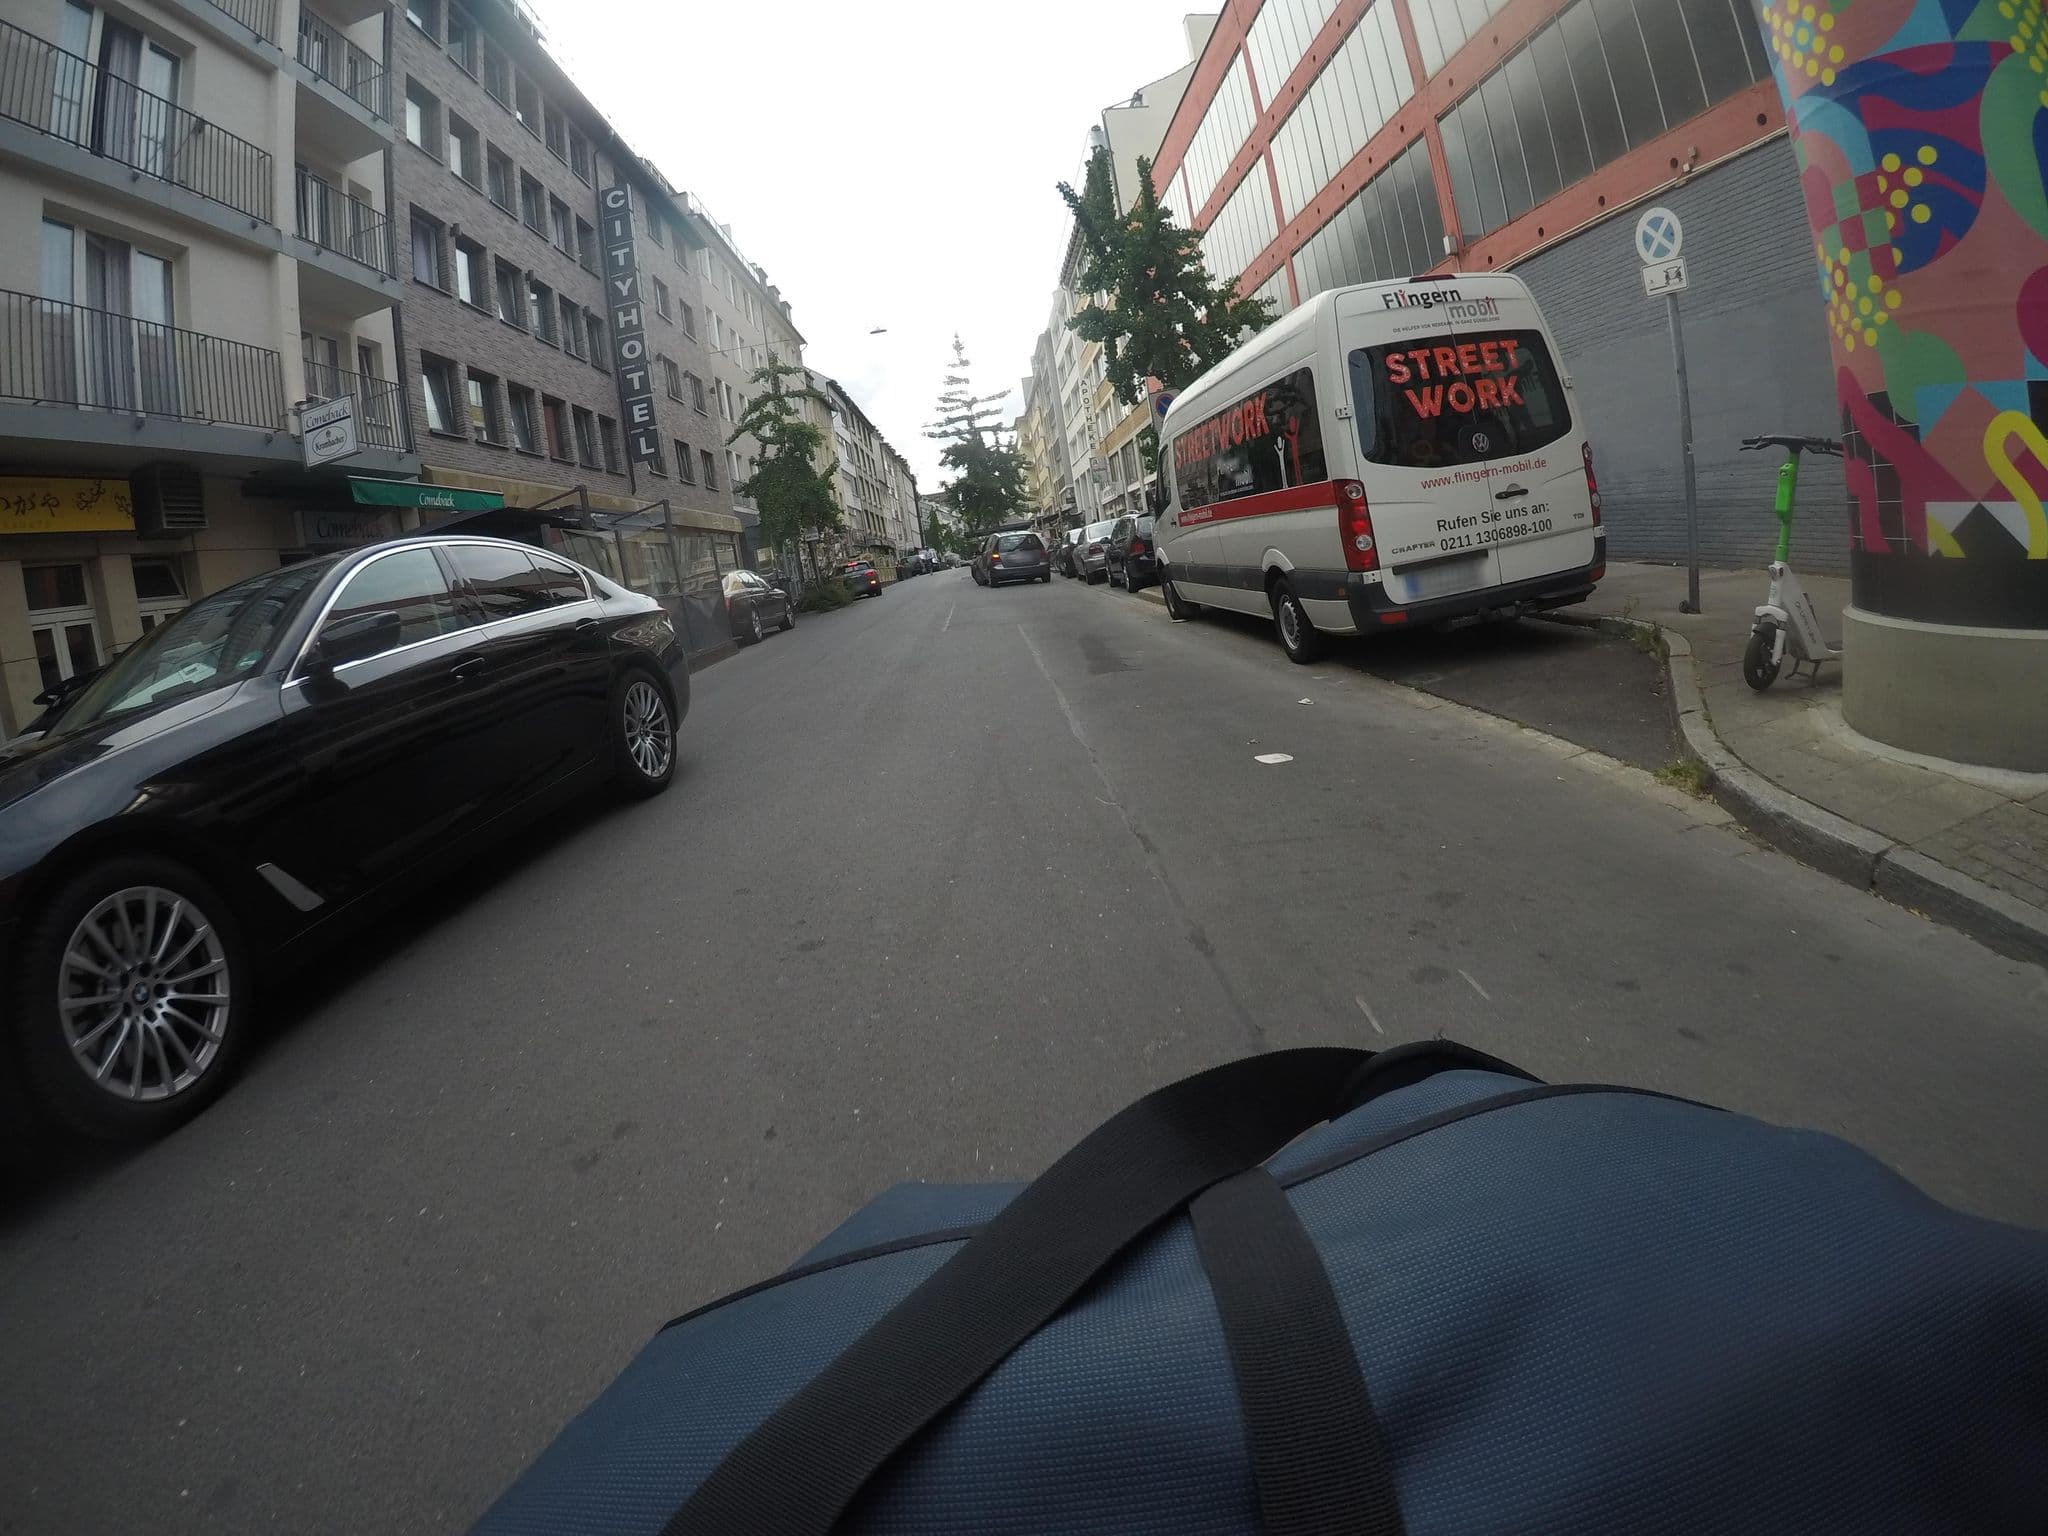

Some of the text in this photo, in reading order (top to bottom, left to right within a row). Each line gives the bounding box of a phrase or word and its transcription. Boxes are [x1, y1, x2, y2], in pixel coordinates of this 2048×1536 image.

[1382, 289, 1461, 309] Flingern
[1449, 296, 1499, 319] mobil
[1385, 340, 1520, 384] STREET
[1404, 375, 1525, 419] WORK
[306, 404, 349, 428] Comeback
[1080, 380, 1096, 450] APOTHEKE
[1420, 458, 1548, 489] www.flingern-mobil.de
[419, 493, 456, 507] Comeback
[1437, 502, 1550, 532] Rufen Sie uns an:
[1391, 540, 1436, 555] CRAFTER
[1440, 518, 1552, 551] 0211 1306898-100
